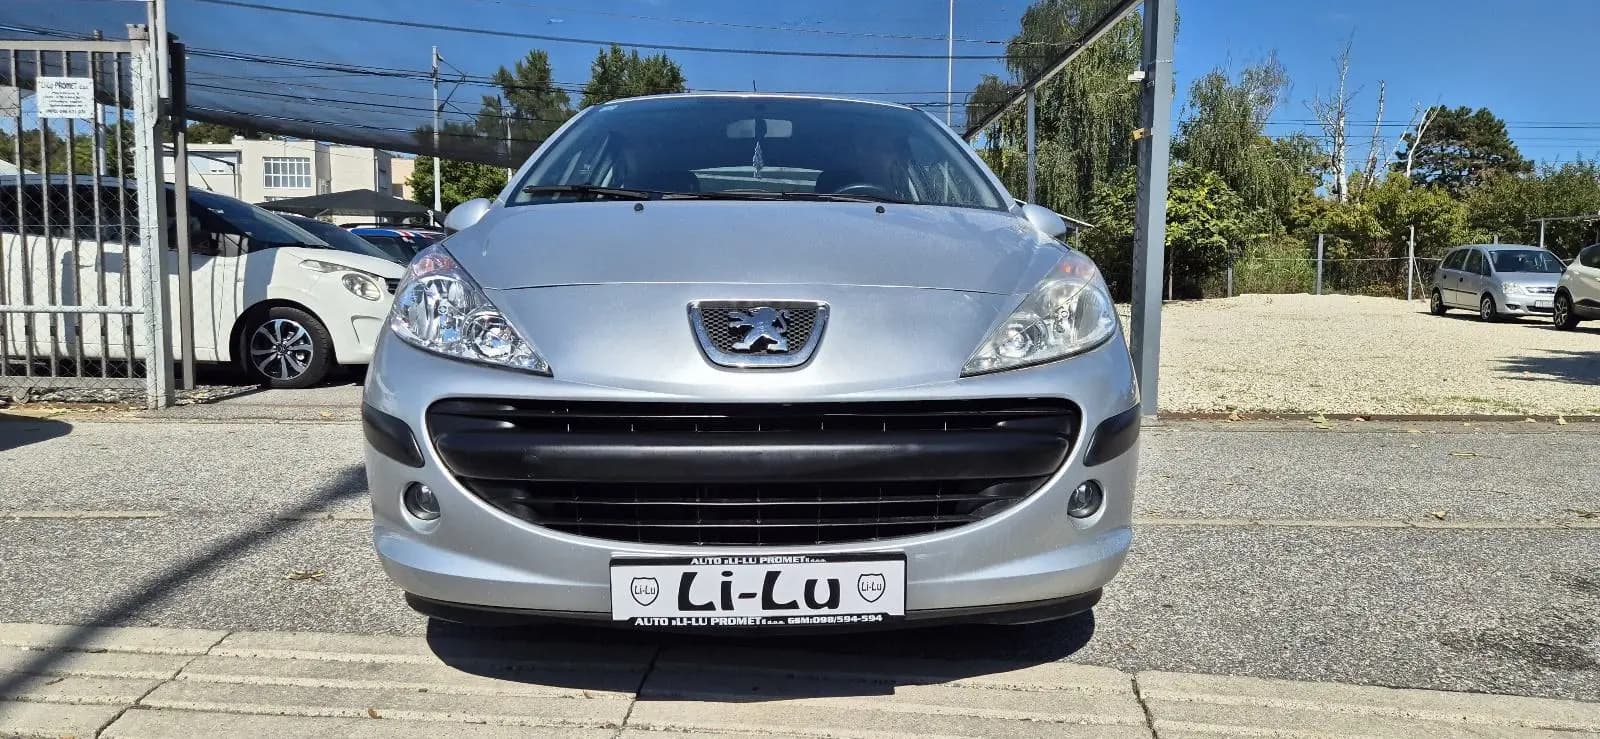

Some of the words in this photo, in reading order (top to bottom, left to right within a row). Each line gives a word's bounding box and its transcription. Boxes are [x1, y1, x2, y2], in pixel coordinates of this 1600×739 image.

[690, 557, 722, 565] AUTO
[634, 584, 656, 595] Li-Lu
[677, 570, 841, 612] Li-Lu
[861, 581, 882, 592] Li-Lu
[634, 617, 669, 626] AUTO
